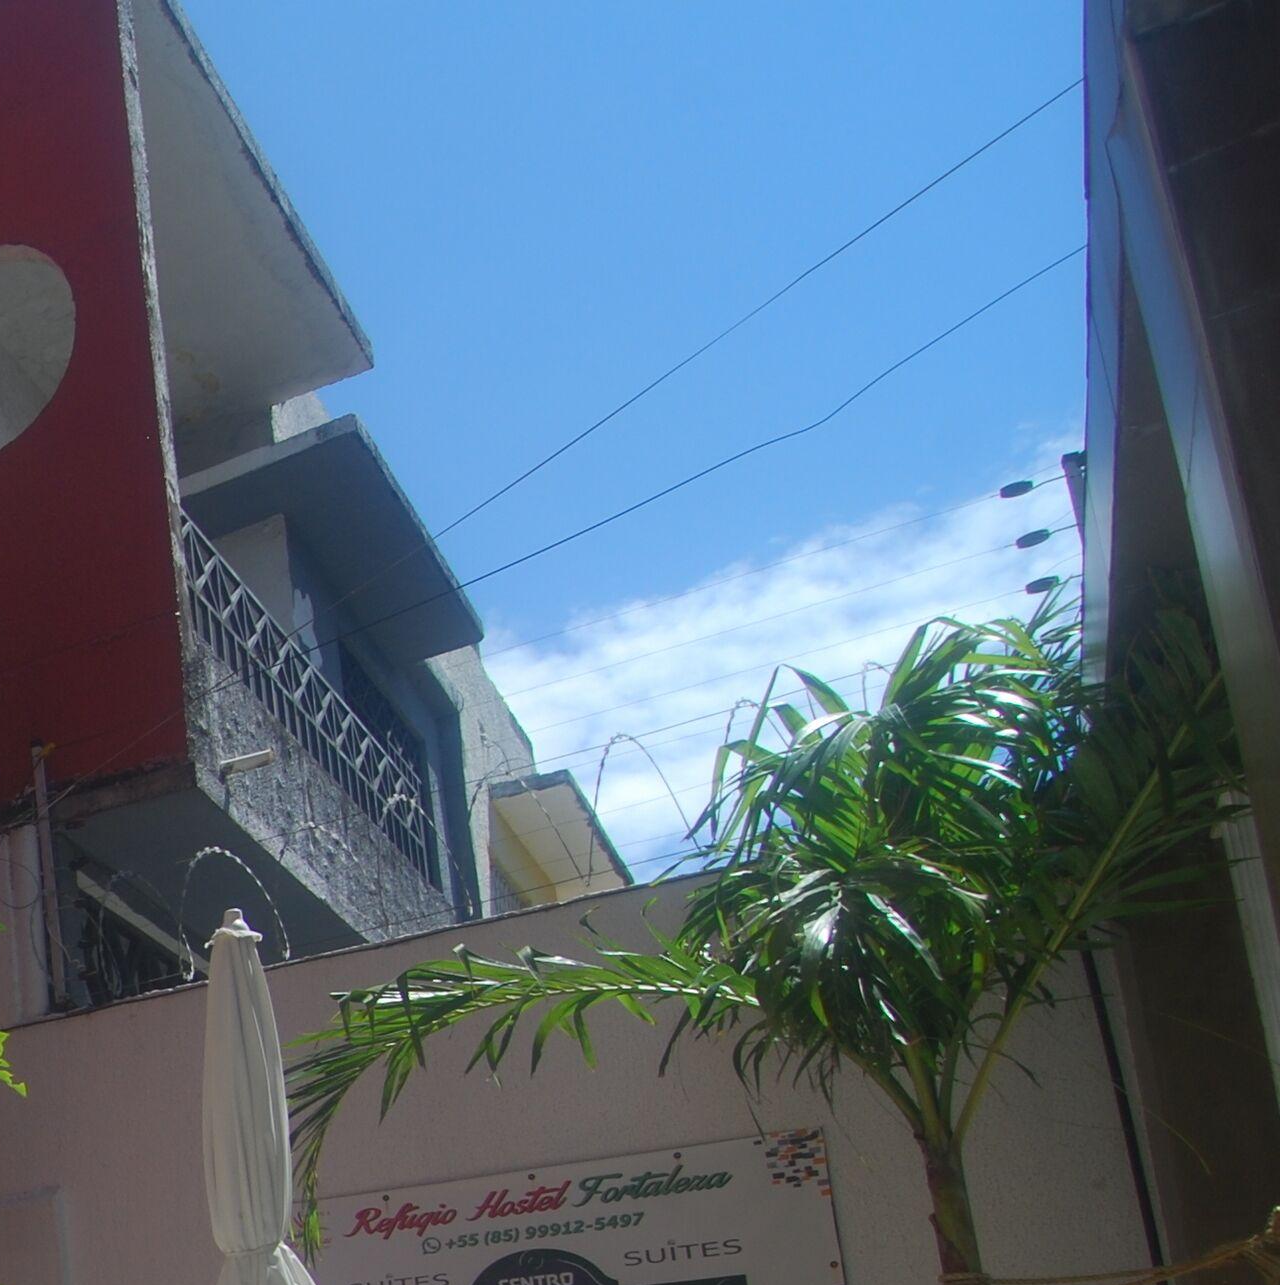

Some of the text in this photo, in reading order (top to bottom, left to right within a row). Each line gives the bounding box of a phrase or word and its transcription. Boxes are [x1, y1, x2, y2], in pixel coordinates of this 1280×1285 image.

[466, 1179, 572, 1221] Hostel
[572, 1163, 733, 1207] Fortaleza
[444, 1211, 645, 1249] +55 (85) 99912-5497
